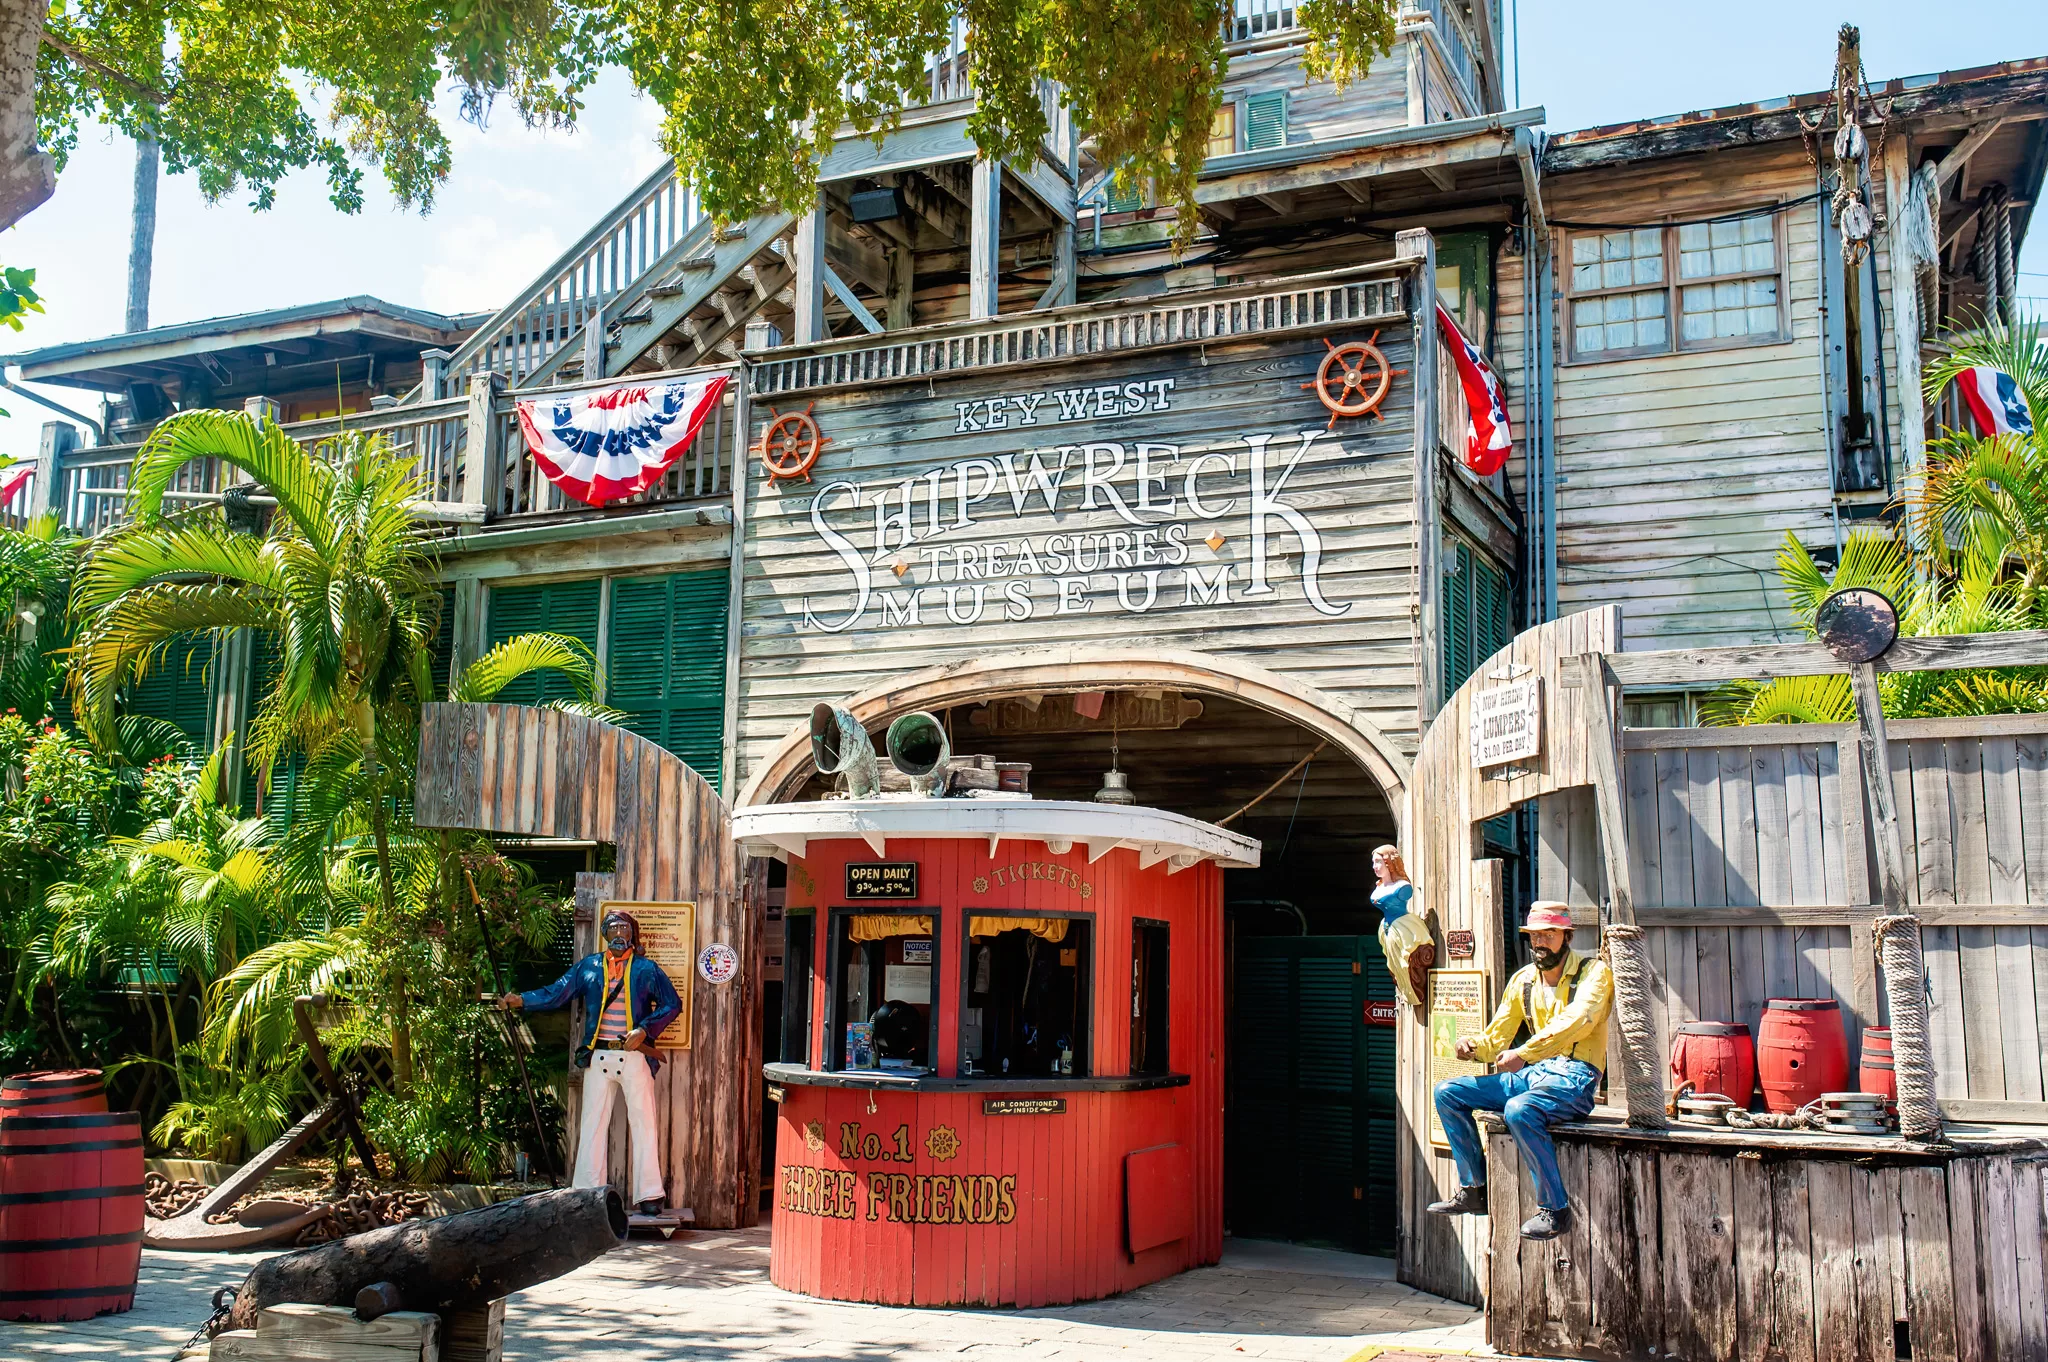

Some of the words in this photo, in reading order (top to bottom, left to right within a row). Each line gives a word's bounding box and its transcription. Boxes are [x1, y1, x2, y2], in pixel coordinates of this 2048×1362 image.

[954, 394, 1045, 434] KEY
[1051, 378, 1177, 422] WEST
[802, 428, 1352, 634] SHIPWRECK
[919, 521, 1191, 584] TREASURES
[878, 563, 1236, 628] MUSEUM
[1482, 693, 1498, 711] NOW
[1500, 687, 1523, 707] HIRING
[1483, 709, 1526, 740] LUMPERS
[1484, 743, 1501, 759] $1.00
[1502, 740, 1514, 755] PER
[1515, 736, 1526, 752] DAY
[851, 868, 880, 879] OPEN
[884, 868, 911, 879] DAILY
[991, 862, 1080, 889] TICKETS
[639, 932, 679, 942] PWRECK
[780, 1164, 857, 1220] THREE
[866, 1171, 1017, 1225] FRIENDS
